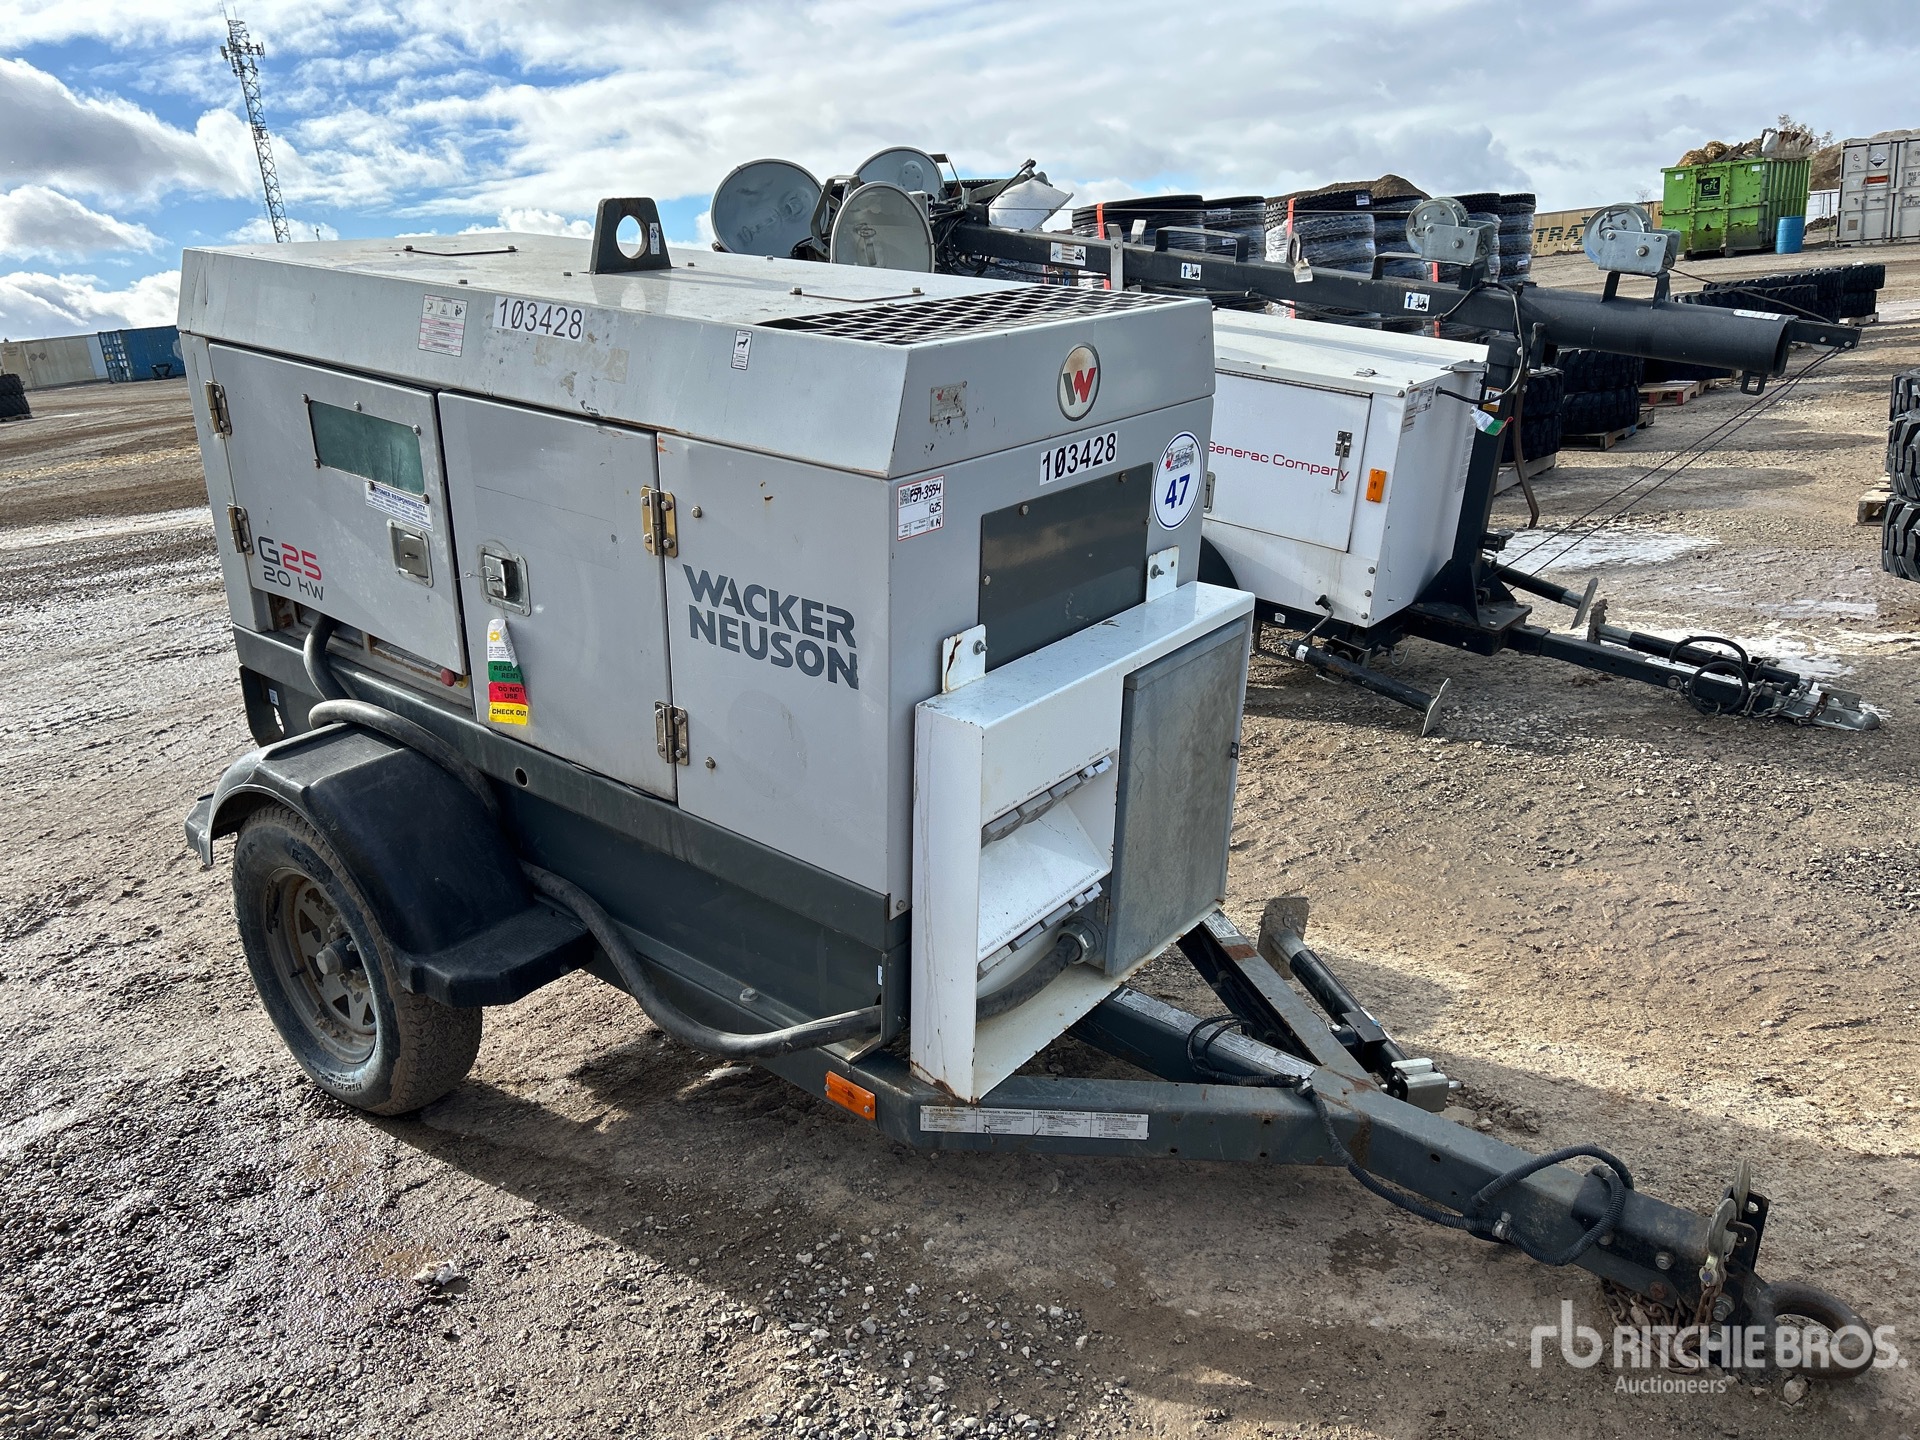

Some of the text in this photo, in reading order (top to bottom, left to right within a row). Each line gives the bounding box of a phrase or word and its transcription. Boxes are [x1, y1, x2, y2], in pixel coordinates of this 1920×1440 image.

[500, 298, 583, 340] 103428
[1042, 432, 1117, 481] 103428
[1165, 474, 1190, 509] 47
[257, 536, 322, 581] G25
[263, 565, 291, 588] 20
[682, 564, 857, 649] WACKER
[688, 604, 859, 690] NEUSON
[504, 692, 518, 700] USE
